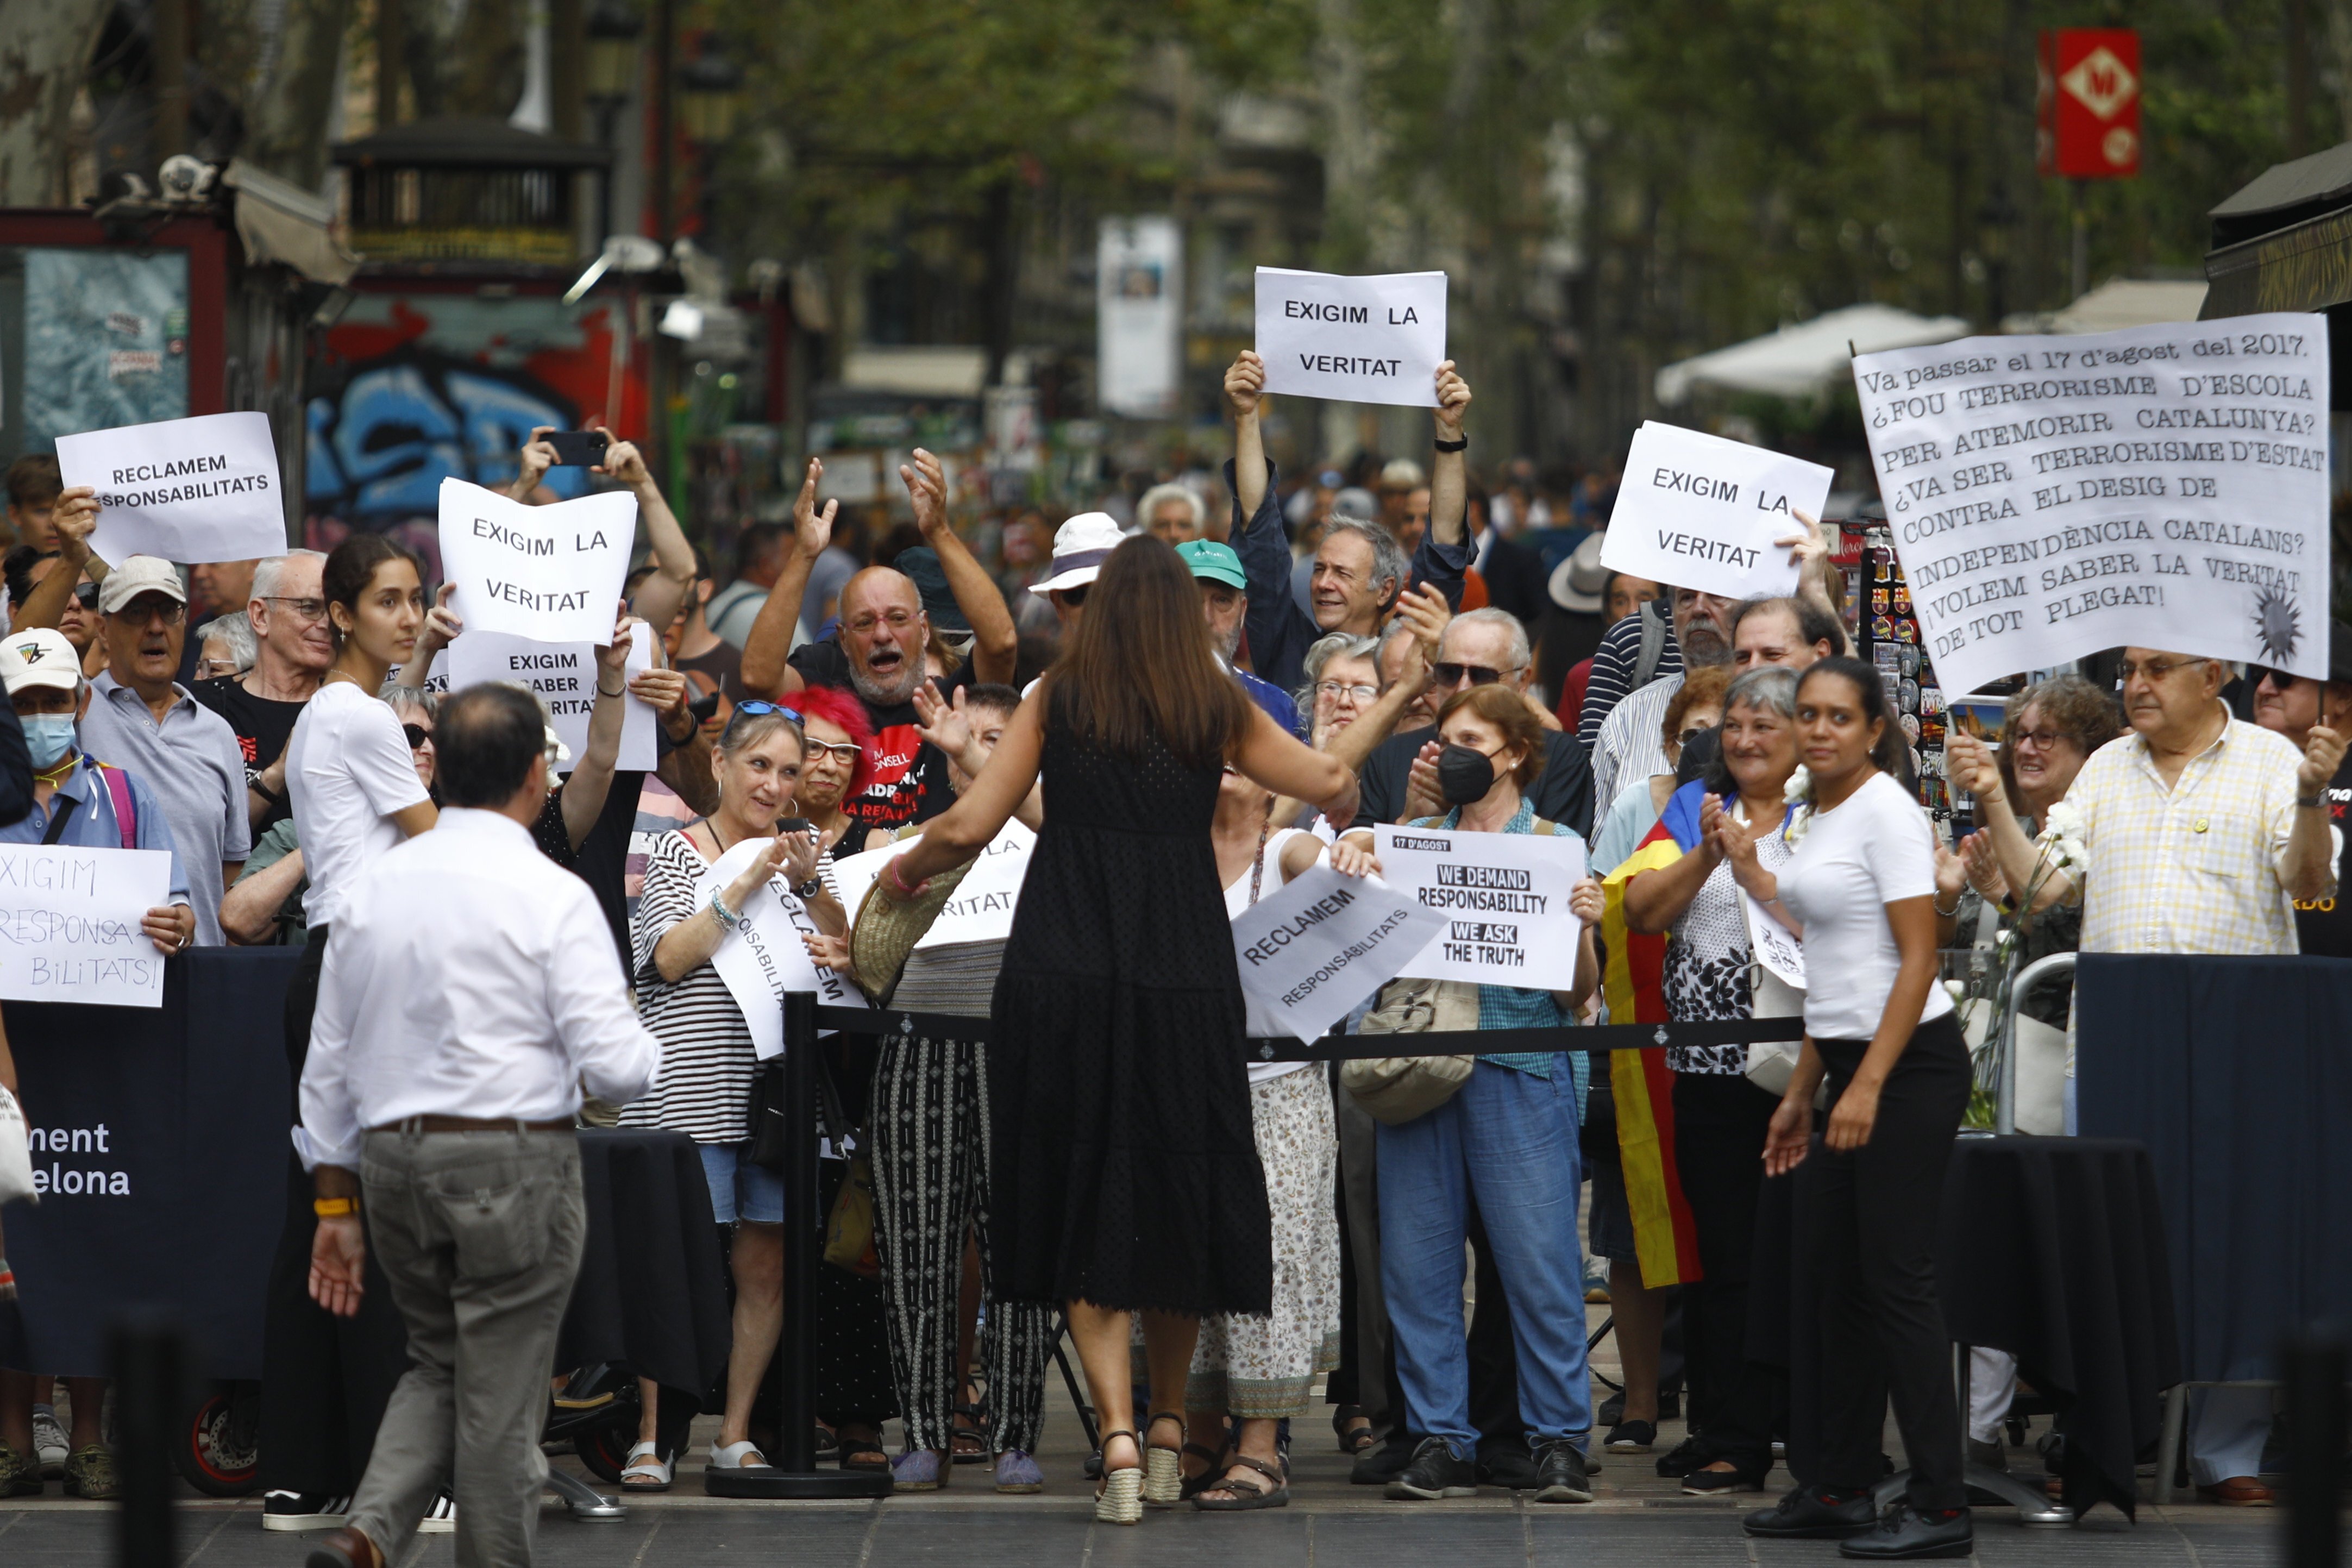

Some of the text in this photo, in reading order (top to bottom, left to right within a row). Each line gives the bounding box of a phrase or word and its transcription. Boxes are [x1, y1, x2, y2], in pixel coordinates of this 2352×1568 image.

[1285, 300, 1418, 325] EXIGIM LA
[1300, 353, 1401, 377] VERITAT
[1861, 334, 2309, 394] Va passar el 17 d'agost del 2017.
[1872, 374, 2313, 428] ¿FOU TERRORISME D'ESCOLA
[1880, 408, 2315, 473] PER ATEMORIR CATALUNYA?
[112, 454, 227, 485] RECLAMEM
[1895, 441, 2324, 512] ¿VA SER TERRORISME D'ESTAT
[93, 474, 269, 507] ESPONSABILITATS
[1653, 468, 1789, 516] EXIGIM LA
[1904, 476, 2217, 544] CONTRA EL DESIG DE
[473, 518, 608, 556] EXIGIM LA
[1658, 529, 1761, 569] VERITAT
[1914, 519, 2304, 590] INDEPENDÈNCIA CATALANS?
[486, 578, 590, 612] VERITAT
[1925, 553, 2300, 630] ¡VOLEM SABER LA VERITAT
[1934, 626, 1966, 660] DE
[1970, 610, 2023, 641] TOT
[2044, 585, 2165, 625] PLEGAT!
[509, 653, 578, 670] EXIGIM
[524, 677, 579, 692] ABER
[1395, 837, 1448, 850] 17 D'AGOST
[0, 854, 96, 896] XIGIM
[1439, 865, 1528, 889] WE DEMAND
[939, 891, 1012, 917] RITAT
[1418, 887, 1547, 914] RESPONSABILITY
[1243, 888, 1356, 967] RECLAMEM
[1454, 922, 1515, 943] WE ASK
[1281, 908, 1408, 1008] RESPONSABILITATS
[1443, 943, 1525, 967] THE TRUTH
[33, 1162, 130, 1195] elona
